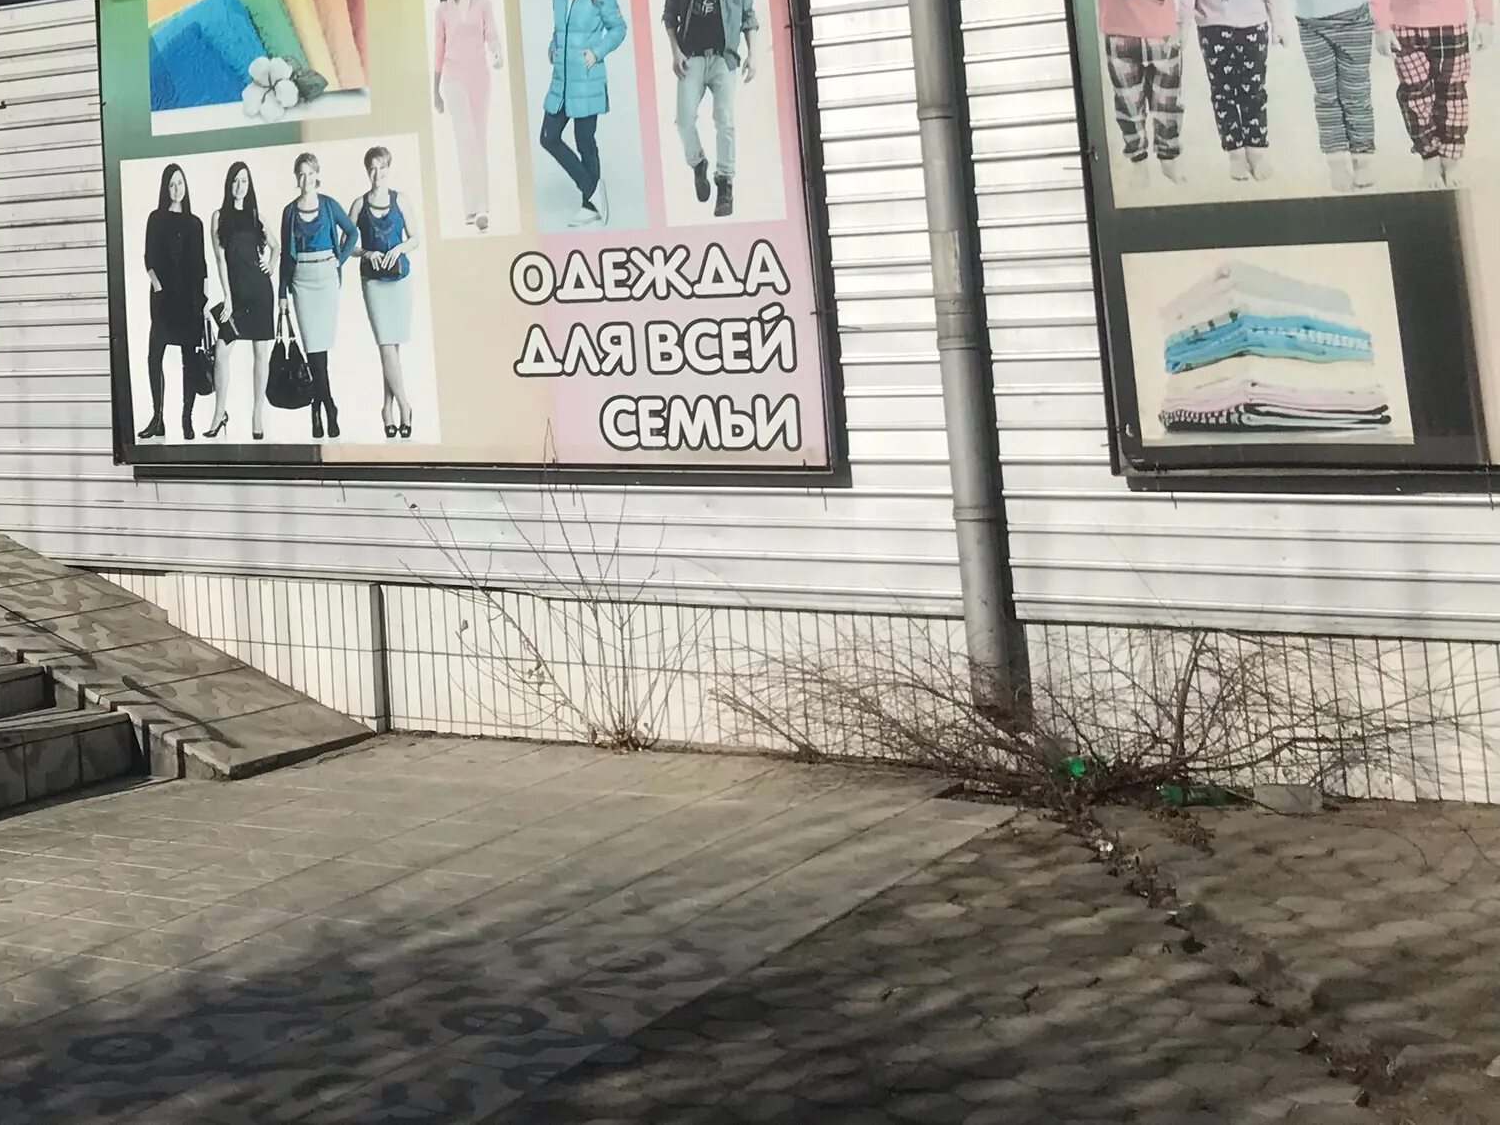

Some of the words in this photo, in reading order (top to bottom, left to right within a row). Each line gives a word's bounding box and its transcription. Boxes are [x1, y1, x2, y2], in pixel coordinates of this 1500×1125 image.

[510, 239, 790, 305] ОДЕЖДА
[513, 322, 636, 378] ДЛЯ
[646, 302, 797, 375] ВСЕЙ
[600, 394, 800, 452] СЕМЬИ
